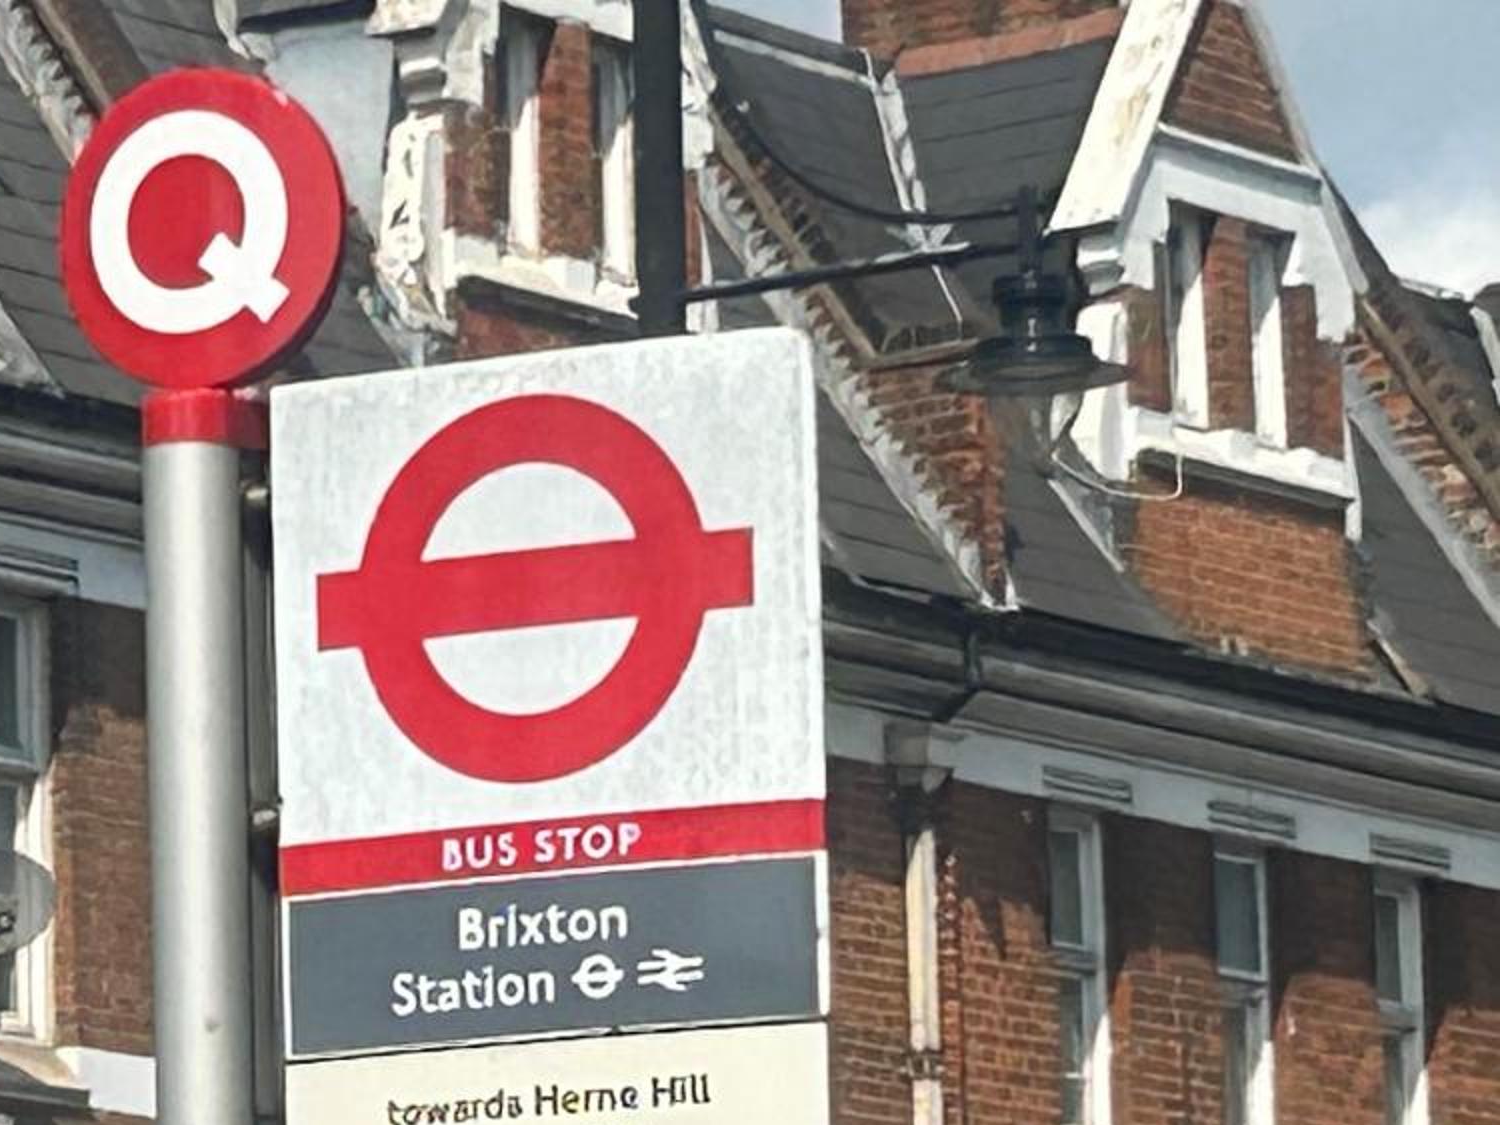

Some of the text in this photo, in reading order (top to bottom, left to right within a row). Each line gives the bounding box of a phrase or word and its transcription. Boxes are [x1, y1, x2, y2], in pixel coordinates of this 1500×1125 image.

[90, 109, 291, 335] Q
[441, 821, 643, 872] BUS STOP
[458, 903, 629, 952] Brixton
[390, 966, 556, 1017] Station
[533, 1084, 639, 1116] Herne
[651, 1073, 712, 1108] Hill
